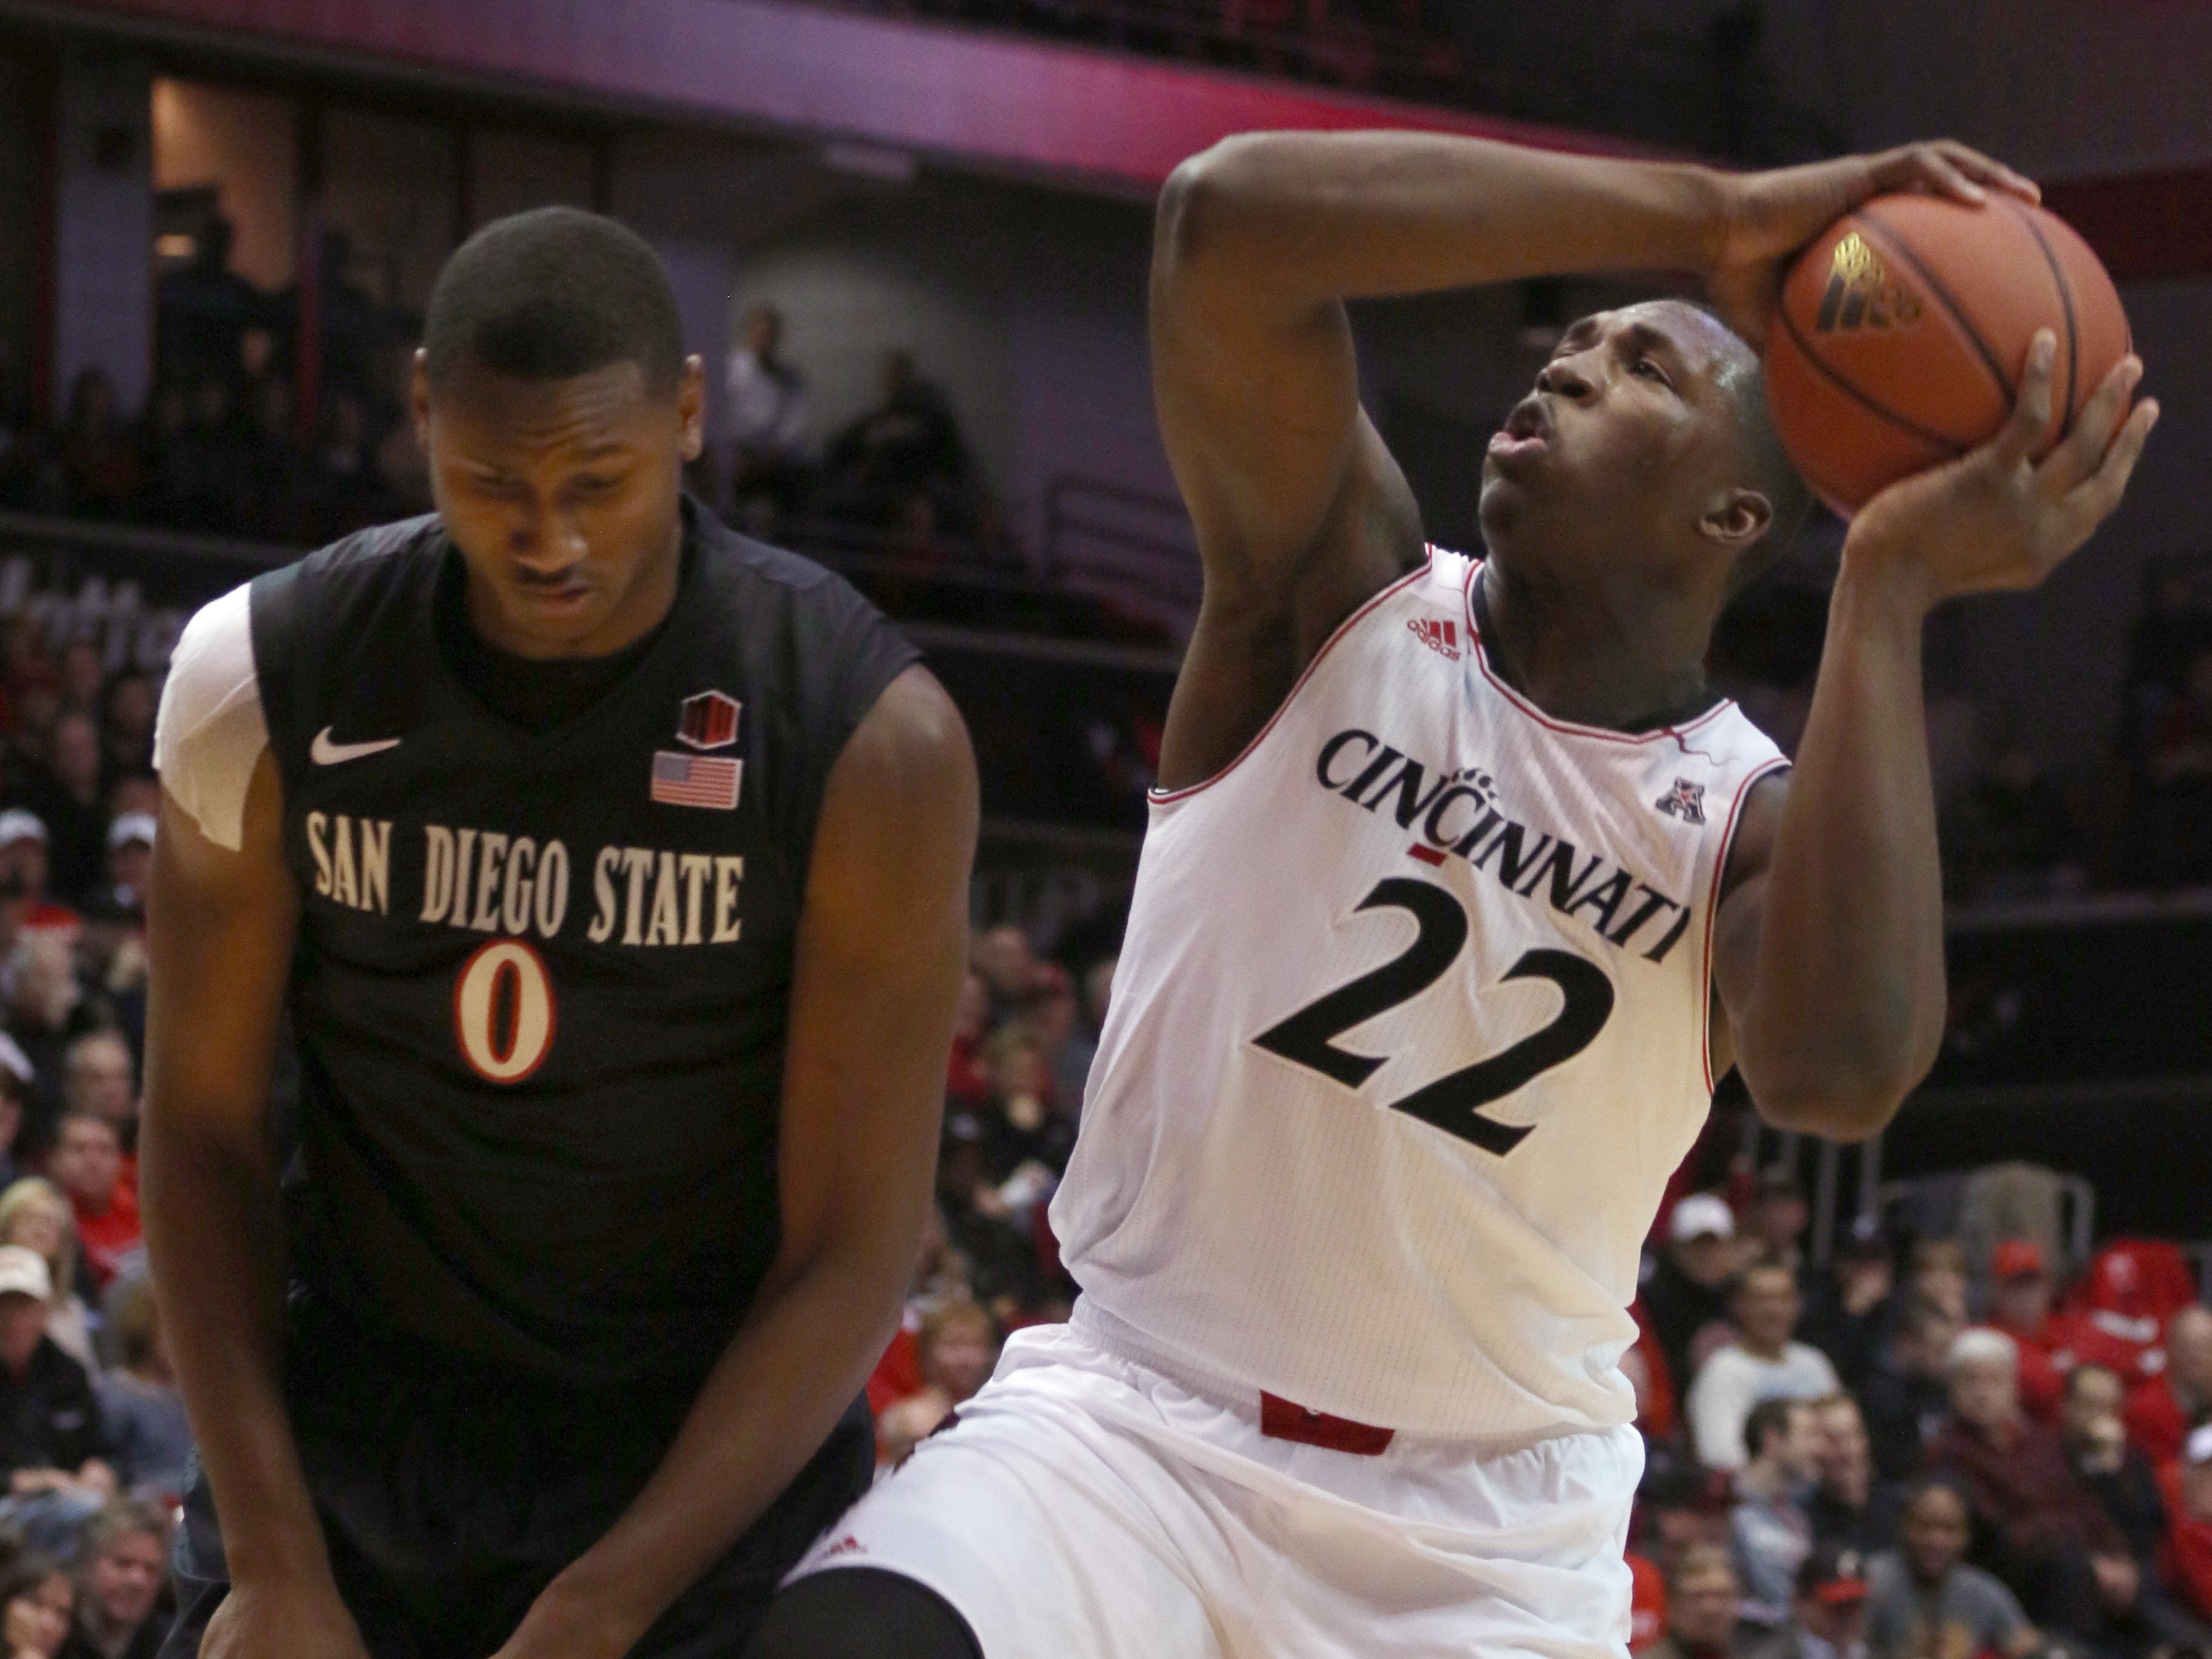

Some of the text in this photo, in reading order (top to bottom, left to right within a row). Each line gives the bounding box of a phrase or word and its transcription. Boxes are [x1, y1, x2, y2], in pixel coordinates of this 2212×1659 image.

[1406, 619, 1461, 662] adidas
[307, 810, 743, 946] SAN DIEGO STATE
[1317, 729, 1692, 963] CINCINNATI
[453, 938, 556, 1083] 0
[1250, 877, 1615, 1157] 22
